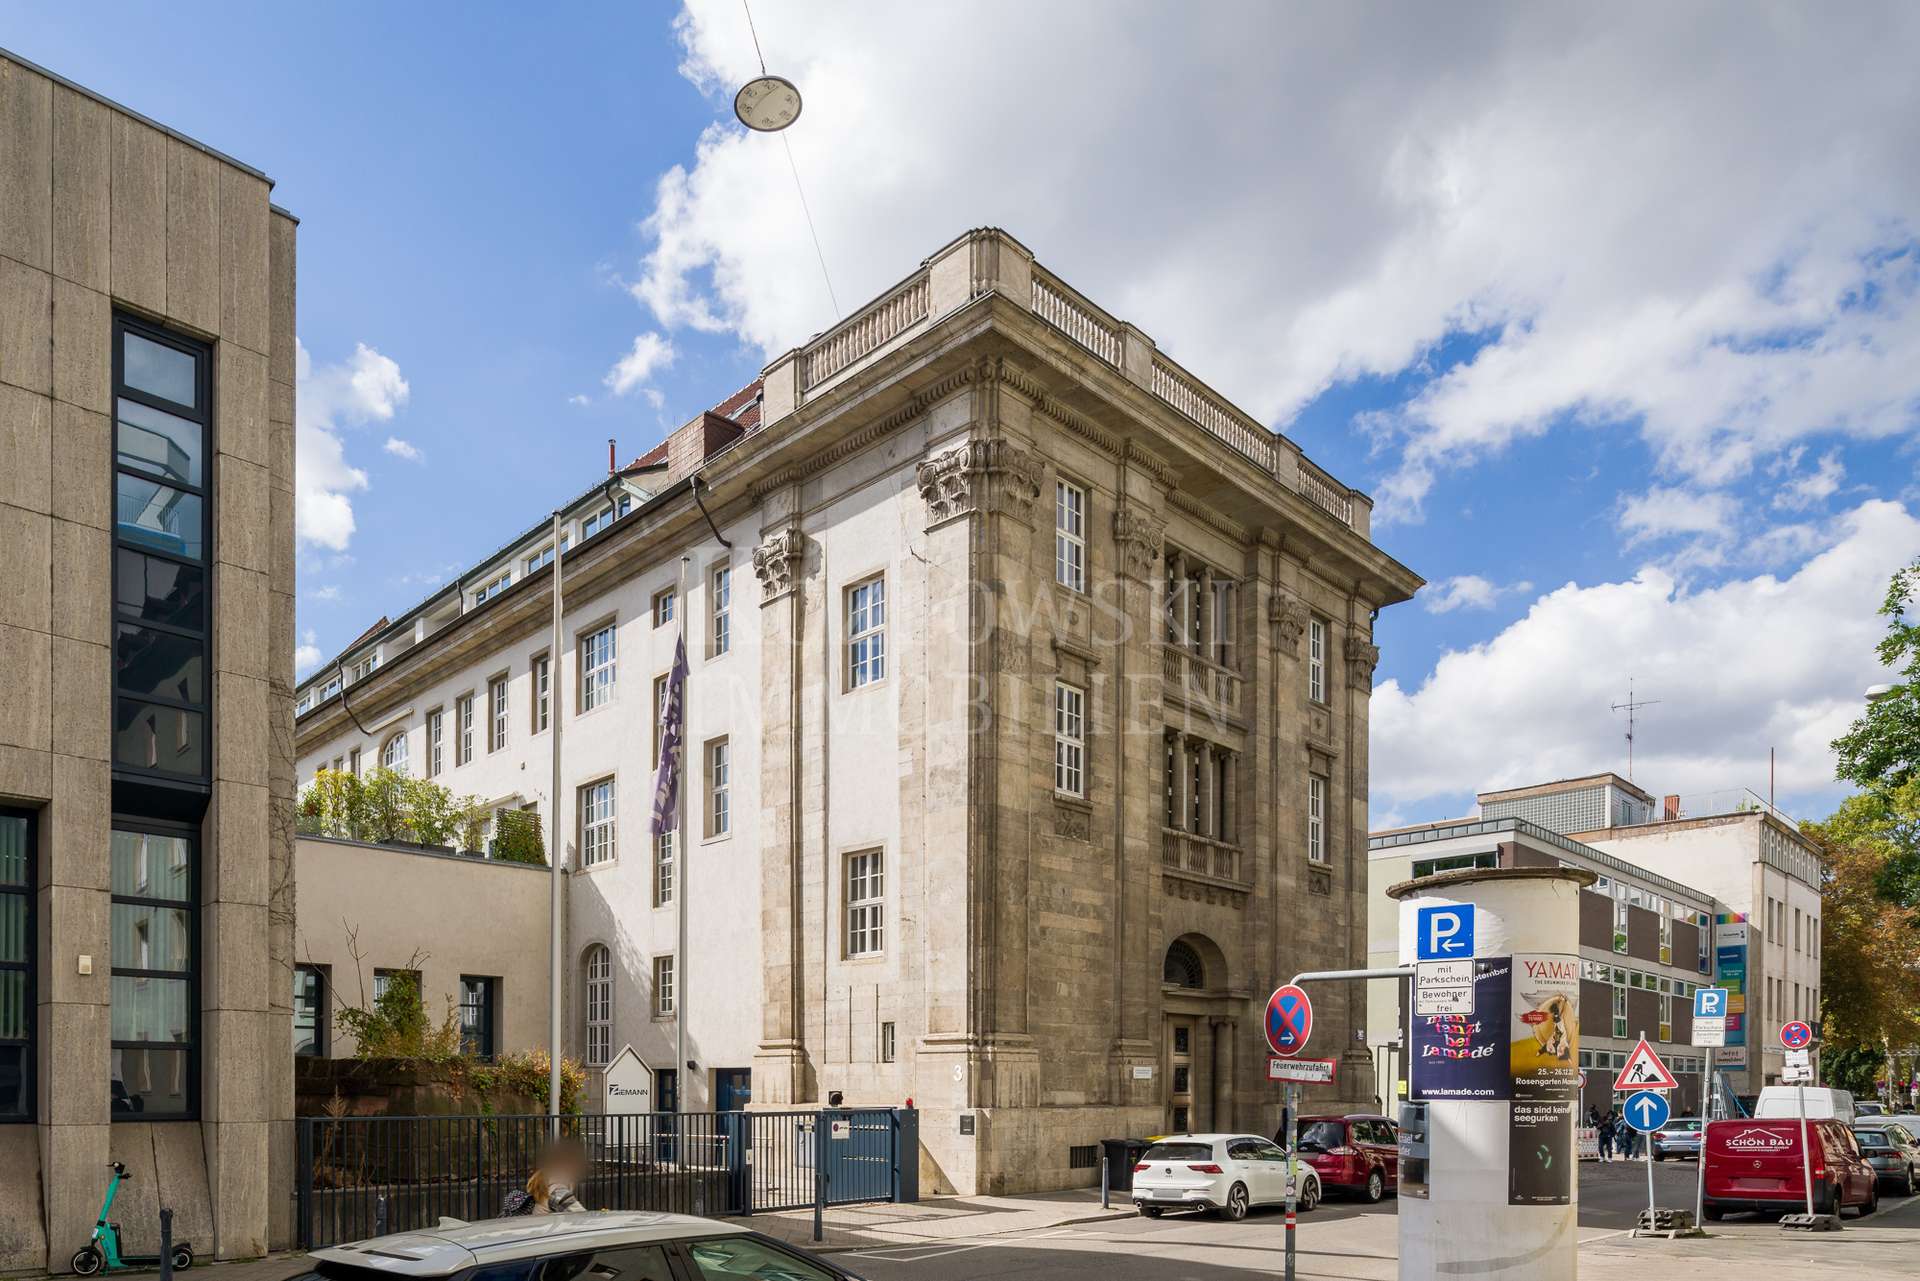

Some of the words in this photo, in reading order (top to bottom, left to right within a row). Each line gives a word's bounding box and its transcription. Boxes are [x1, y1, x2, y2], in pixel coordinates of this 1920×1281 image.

[1430, 912, 1461, 953] P
[1437, 965, 1452, 973] mit
[1474, 967, 1509, 983] ptember
[1422, 990, 1468, 999] Bewohner
[1437, 1004, 1453, 1012] frei
[1701, 992, 1720, 1015] P
[1435, 1020, 1482, 1035] tanzt
[1443, 1033, 1472, 1047] bei
[1421, 1042, 1496, 1059] Lamadé
[952, 1064, 963, 1081] 3
[1515, 1077, 1562, 1087] Rosengarten
[1421, 1088, 1495, 1096] www.lamade.com
[1514, 1105, 1532, 1114] das
[1533, 1105, 1552, 1114] sind
[1514, 1114, 1559, 1124] seegurken
[1725, 1137, 1765, 1147] SCHÖN
[1769, 1138, 1794, 1147] BAU
